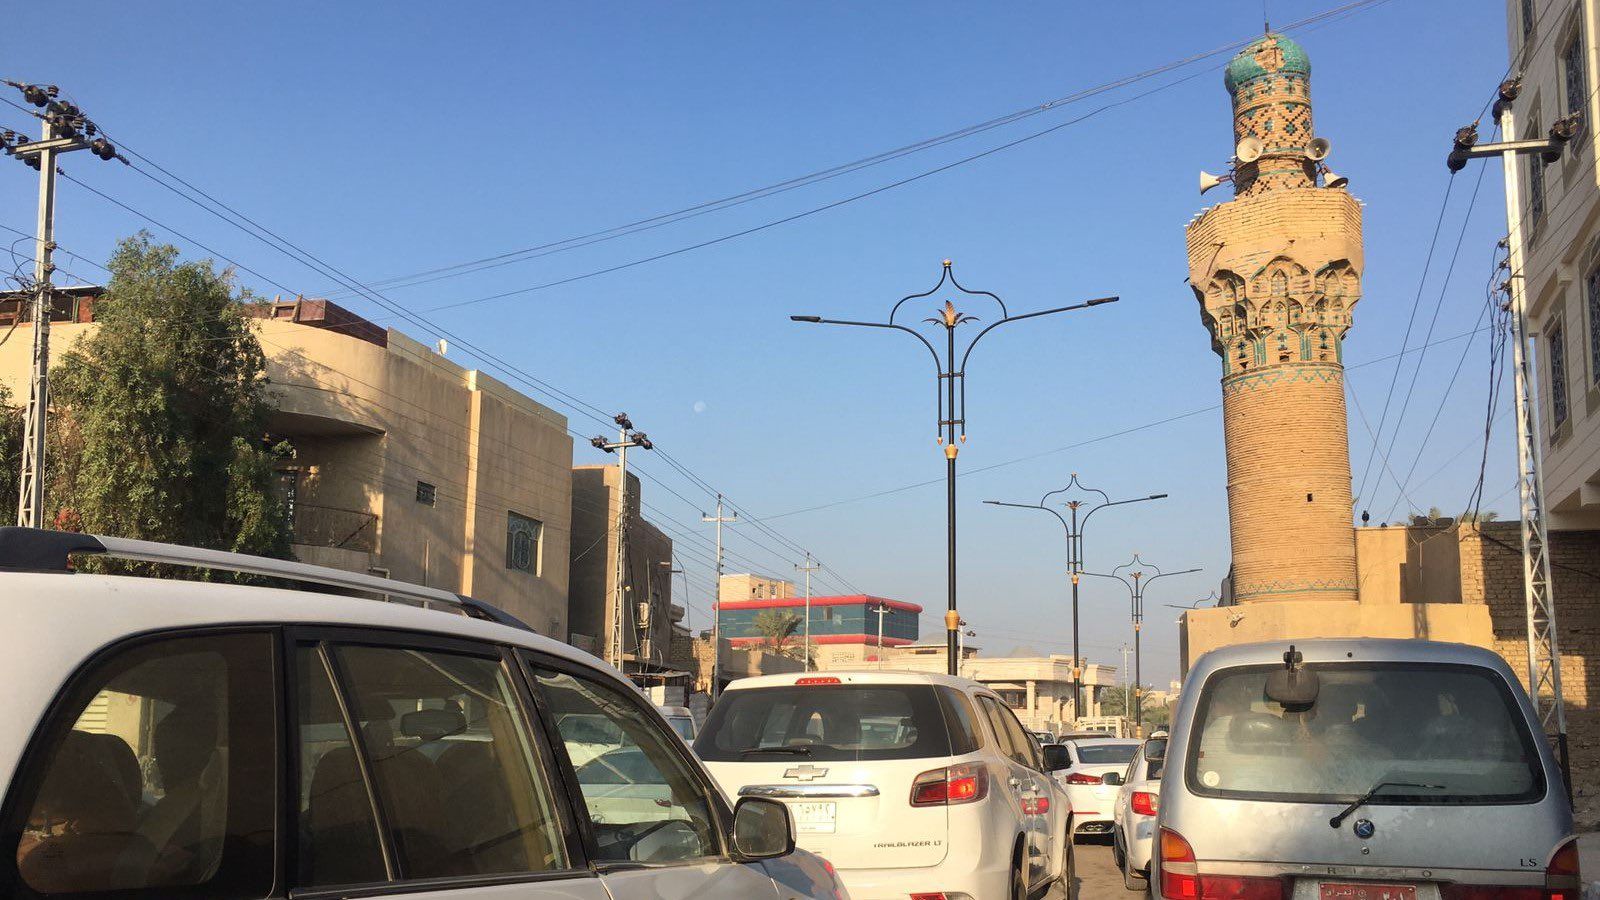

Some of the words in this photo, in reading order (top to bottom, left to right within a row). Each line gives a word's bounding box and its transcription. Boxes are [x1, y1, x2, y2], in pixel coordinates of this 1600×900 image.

[873, 840, 931, 848] TRAILBLAZER
[934, 839, 943, 847] LT
[1519, 858, 1537, 868] LS
